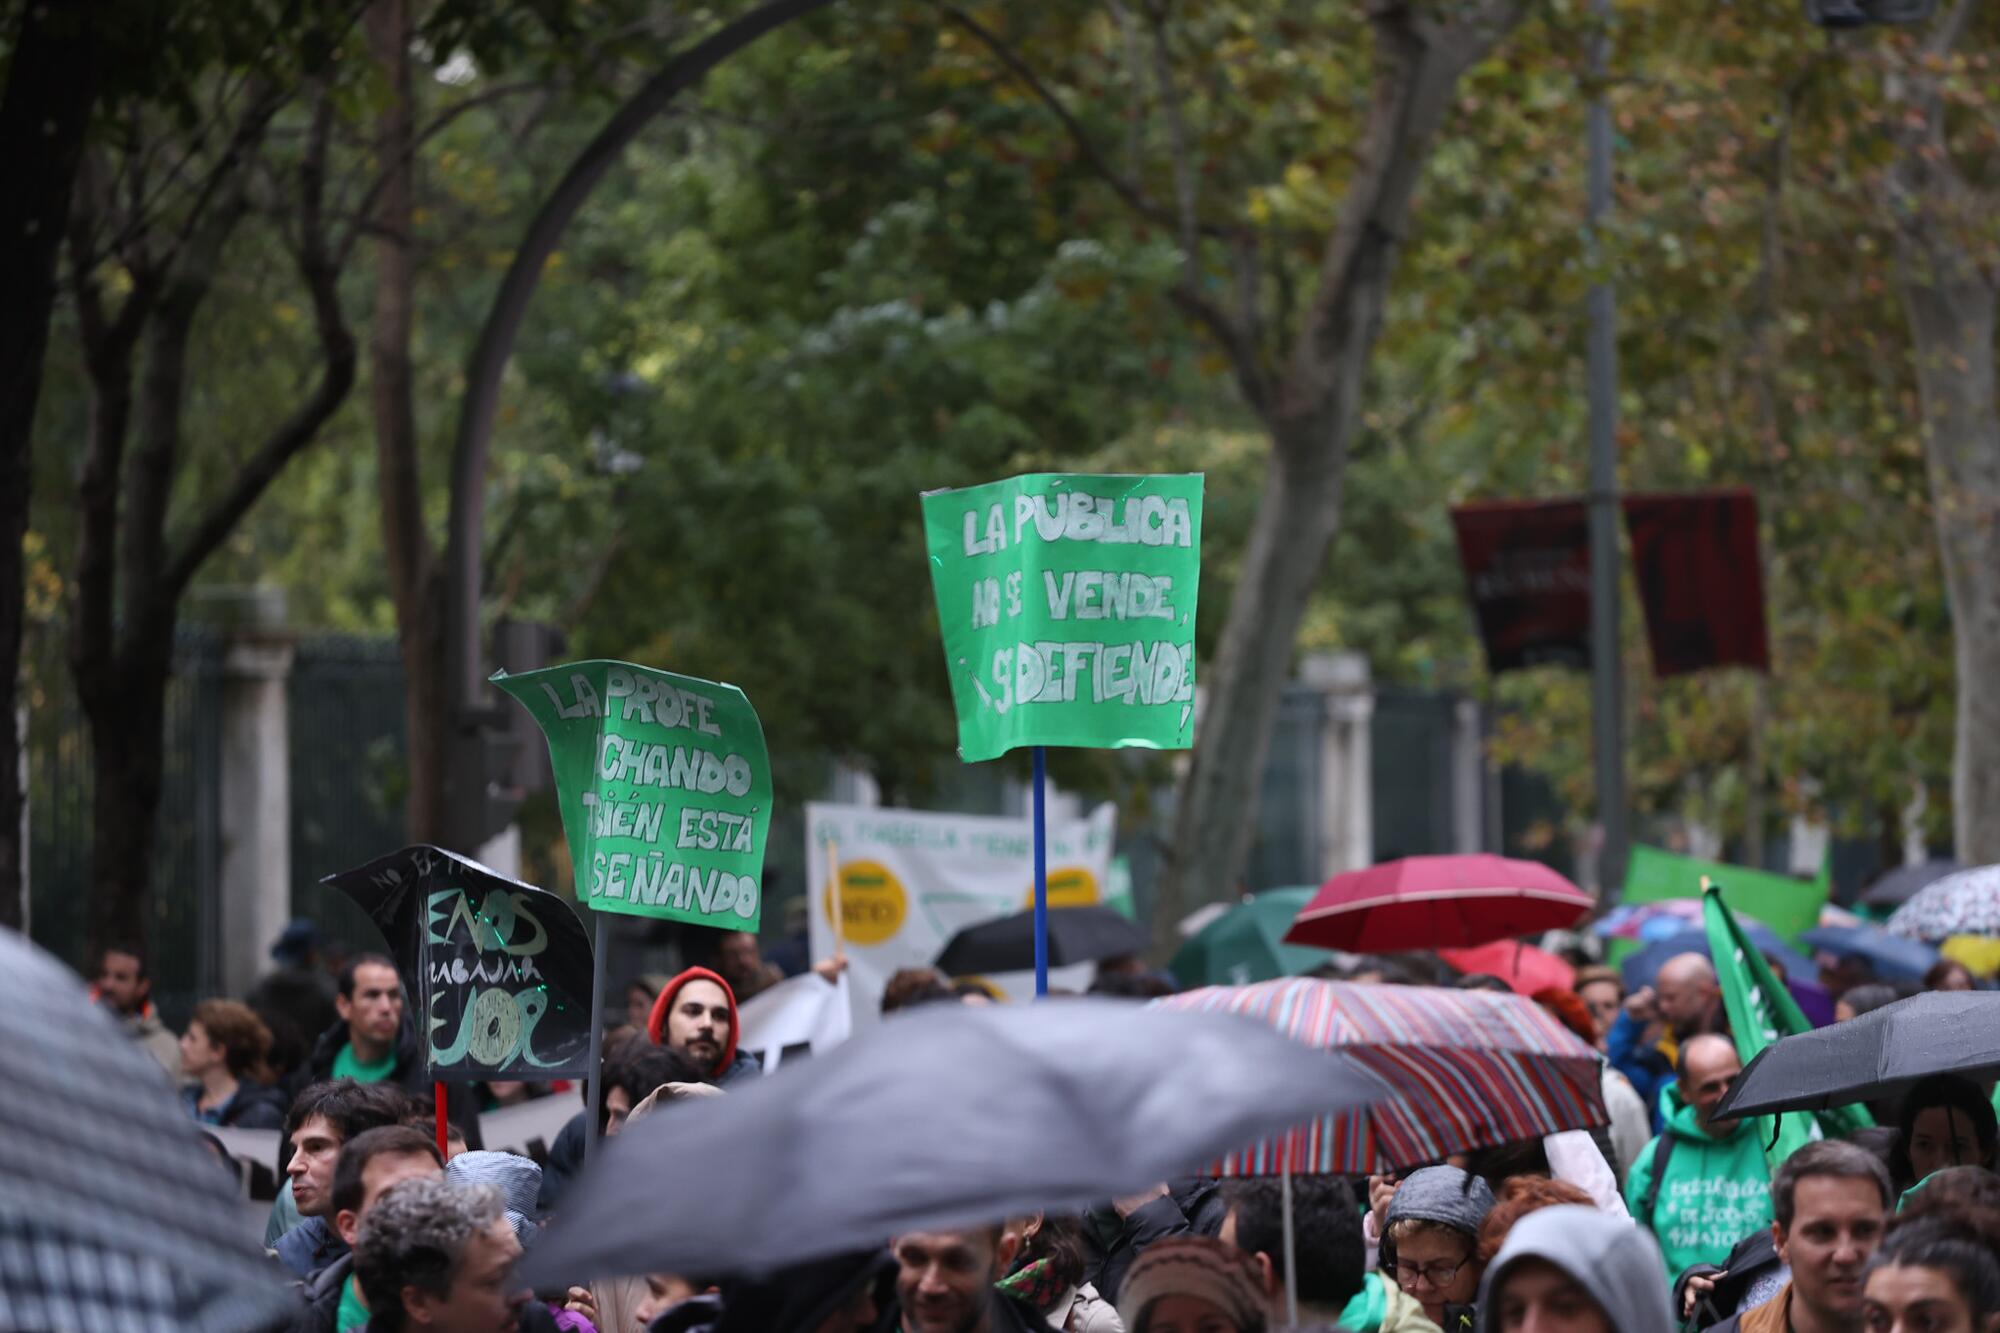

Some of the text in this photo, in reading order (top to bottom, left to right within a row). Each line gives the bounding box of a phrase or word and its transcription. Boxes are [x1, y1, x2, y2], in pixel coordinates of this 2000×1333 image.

[962, 480, 1192, 557] LA PÚBLICA
[540, 666, 721, 737] LA PROFE
[675, 806, 760, 853] ESTÁ
